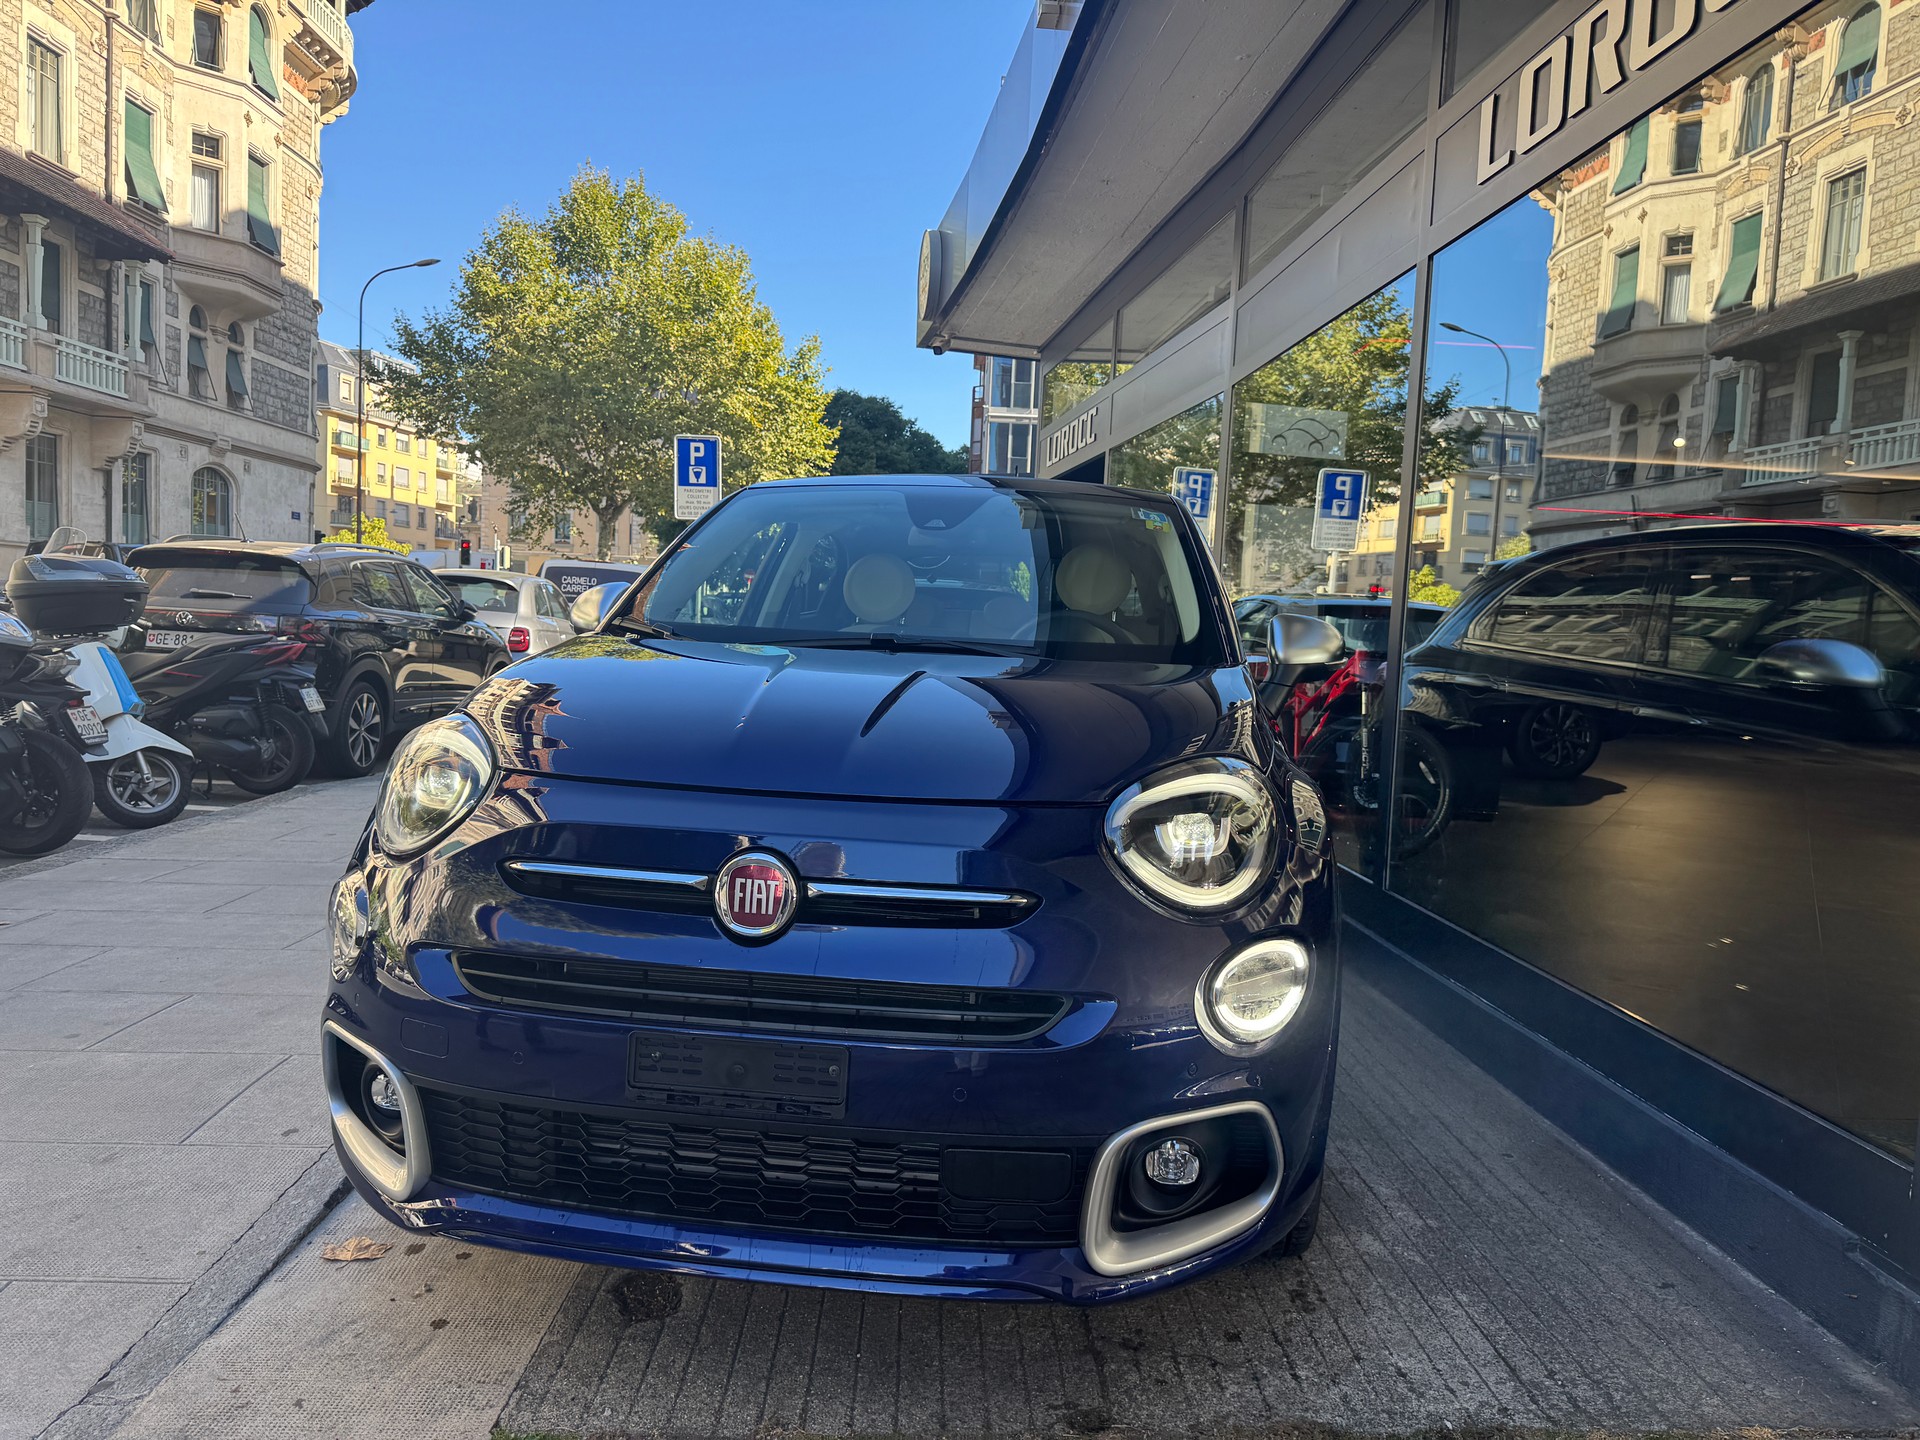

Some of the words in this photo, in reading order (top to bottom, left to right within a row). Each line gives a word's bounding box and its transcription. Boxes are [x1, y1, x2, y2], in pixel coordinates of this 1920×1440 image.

[1477, 0, 1735, 186] LORO
[690, 442, 704, 465] P
[562, 575, 597, 586] CARMELO
[734, 878, 780, 915] FIAT
